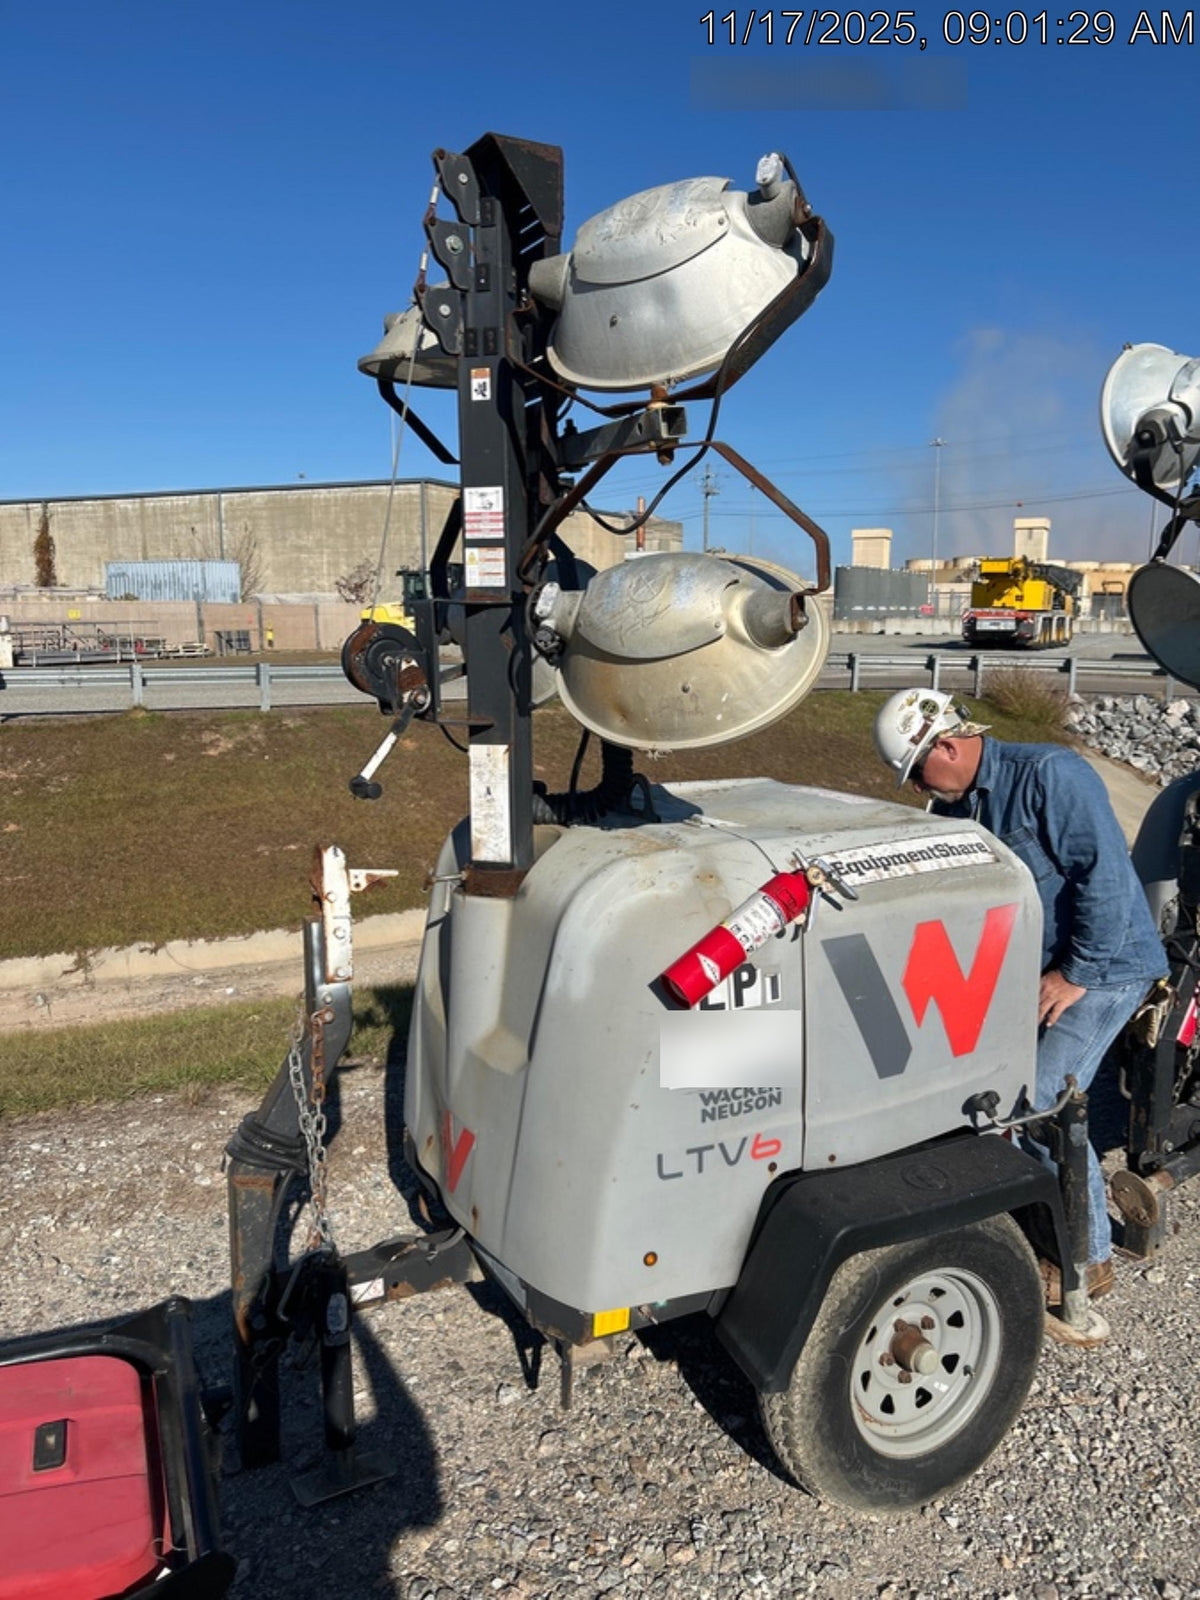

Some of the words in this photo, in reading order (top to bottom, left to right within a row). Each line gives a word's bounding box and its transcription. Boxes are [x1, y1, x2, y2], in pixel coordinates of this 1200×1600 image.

[831, 841, 988, 876] EquipmentShare
[701, 1091, 782, 1123] NEUSON
[657, 1132, 783, 1181] LTV6
